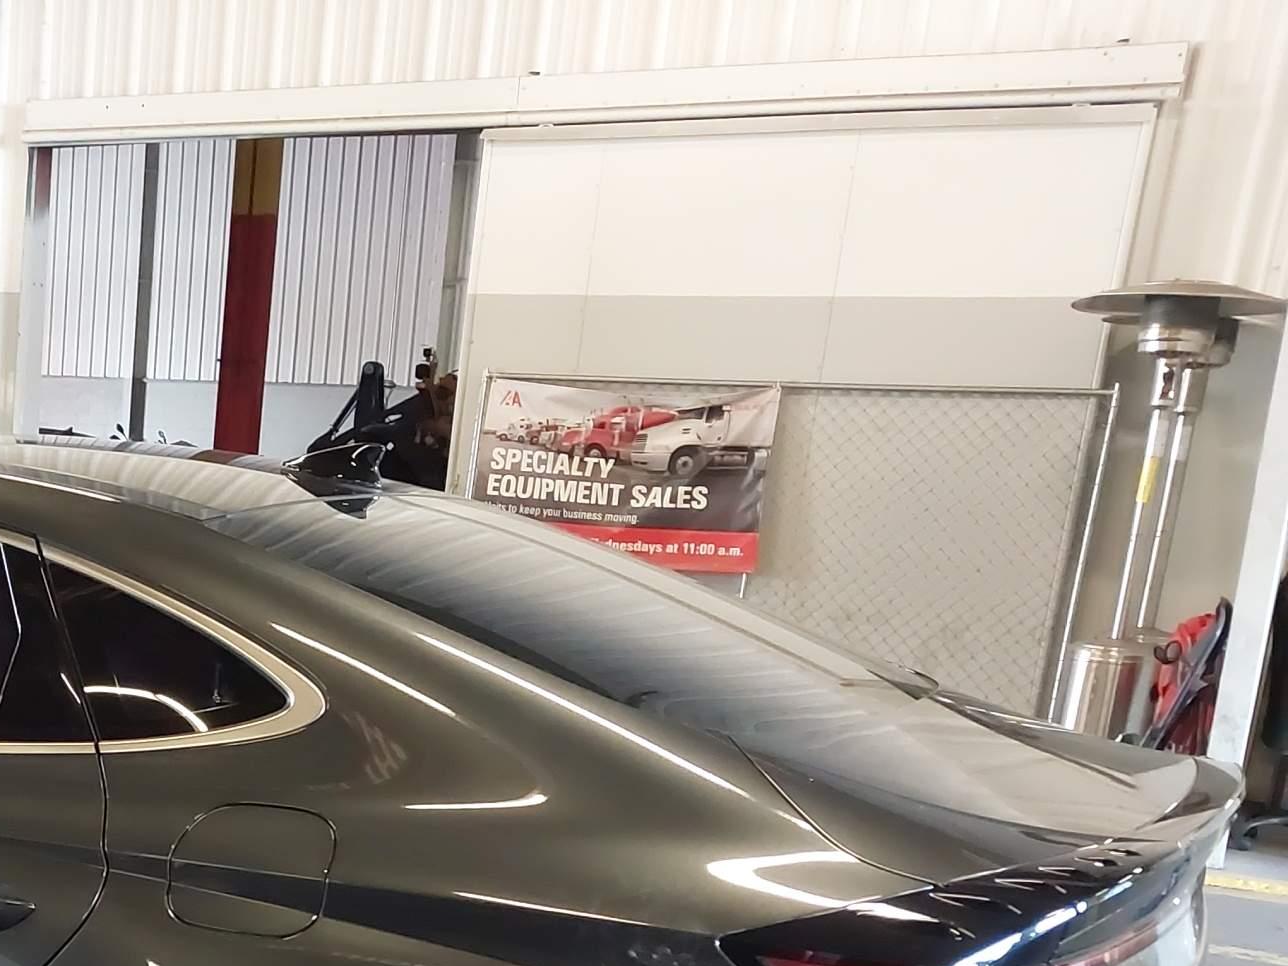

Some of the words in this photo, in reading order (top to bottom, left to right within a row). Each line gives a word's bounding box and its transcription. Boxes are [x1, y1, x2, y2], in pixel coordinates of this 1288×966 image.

[490, 447, 615, 479] SPECIALTY
[486, 474, 624, 507] EQUIPMENT
[630, 484, 709, 511] SALES
[519, 504, 541, 517] keep
[542, 508, 561, 519] your
[562, 509, 603, 521] business
[604, 513, 640, 525] moving.
[591, 537, 663, 555] dnesdays
[665, 543, 679, 554] at
[683, 543, 715, 556] 11:00
[717, 546, 744, 557] a.m.
